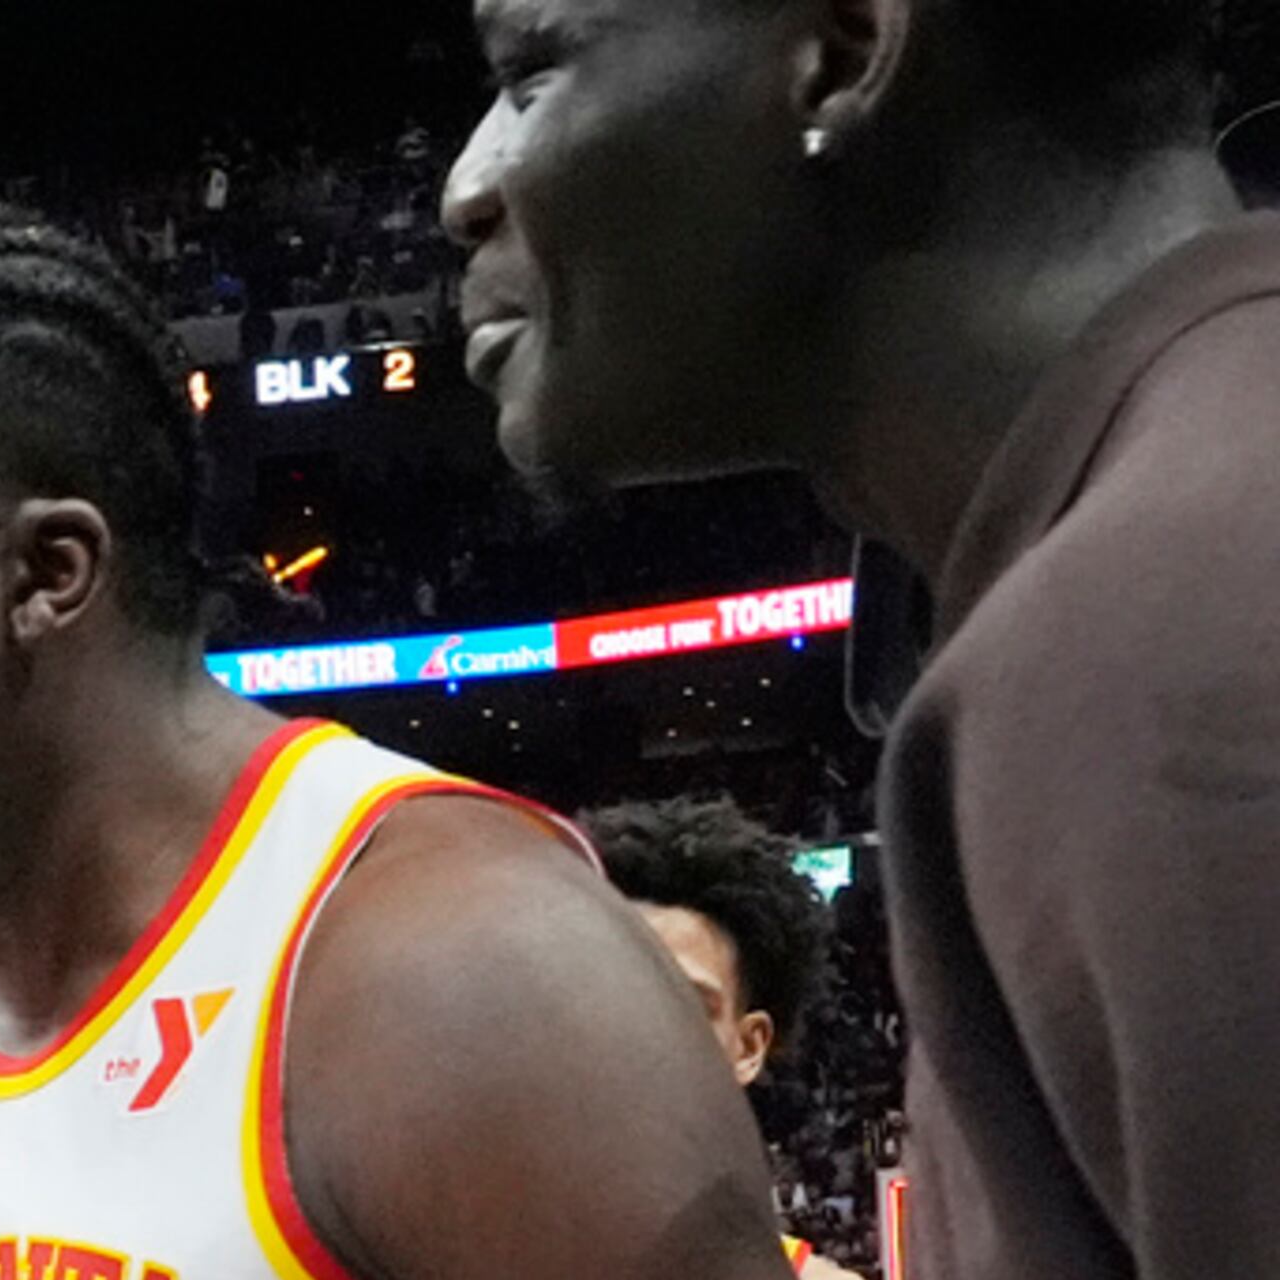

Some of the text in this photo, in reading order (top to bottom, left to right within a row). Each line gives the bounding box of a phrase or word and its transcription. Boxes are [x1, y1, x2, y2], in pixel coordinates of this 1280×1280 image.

[255, 351, 415, 404] BLK 2
[717, 579, 853, 640] TOGETH
[237, 643, 397, 691] TOGETHER
